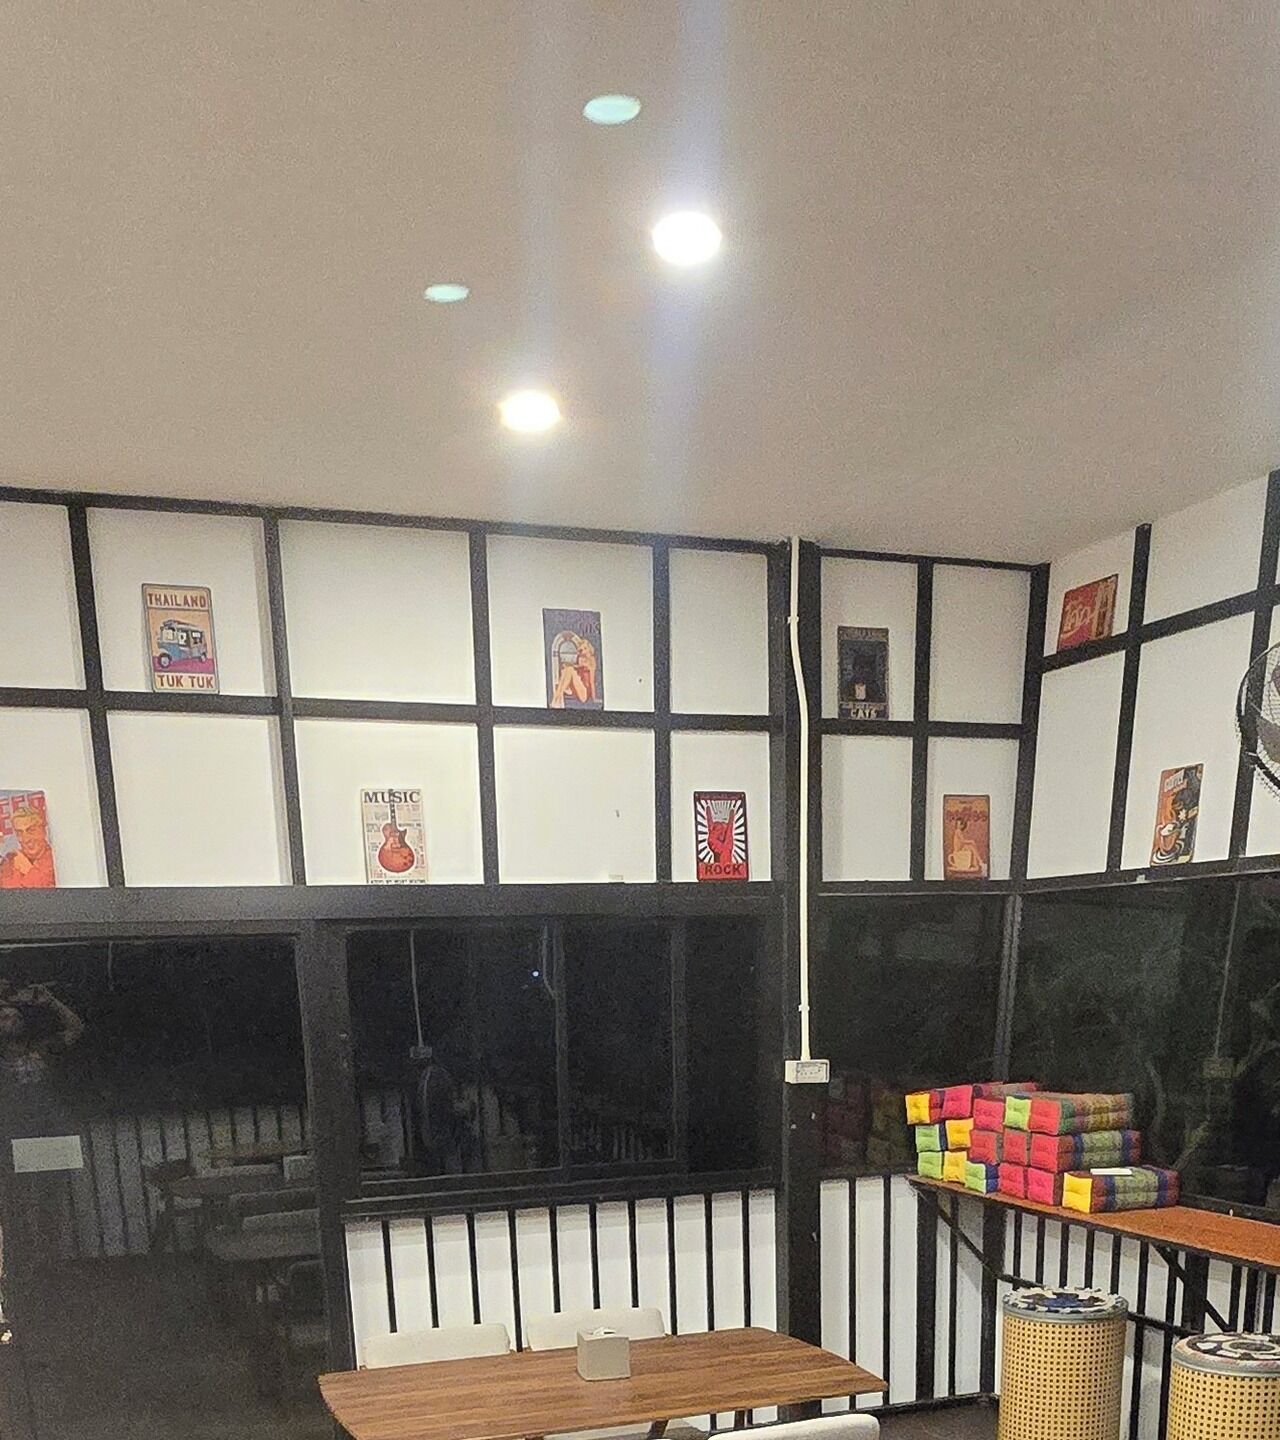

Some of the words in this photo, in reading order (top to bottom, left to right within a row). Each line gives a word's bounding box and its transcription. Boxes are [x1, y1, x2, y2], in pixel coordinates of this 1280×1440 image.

[147, 592, 207, 608] THAILAND
[157, 674, 184, 688] TUK
[188, 675, 214, 689] TUK
[363, 790, 422, 804] MUSIC
[704, 864, 742, 876] ROCK
